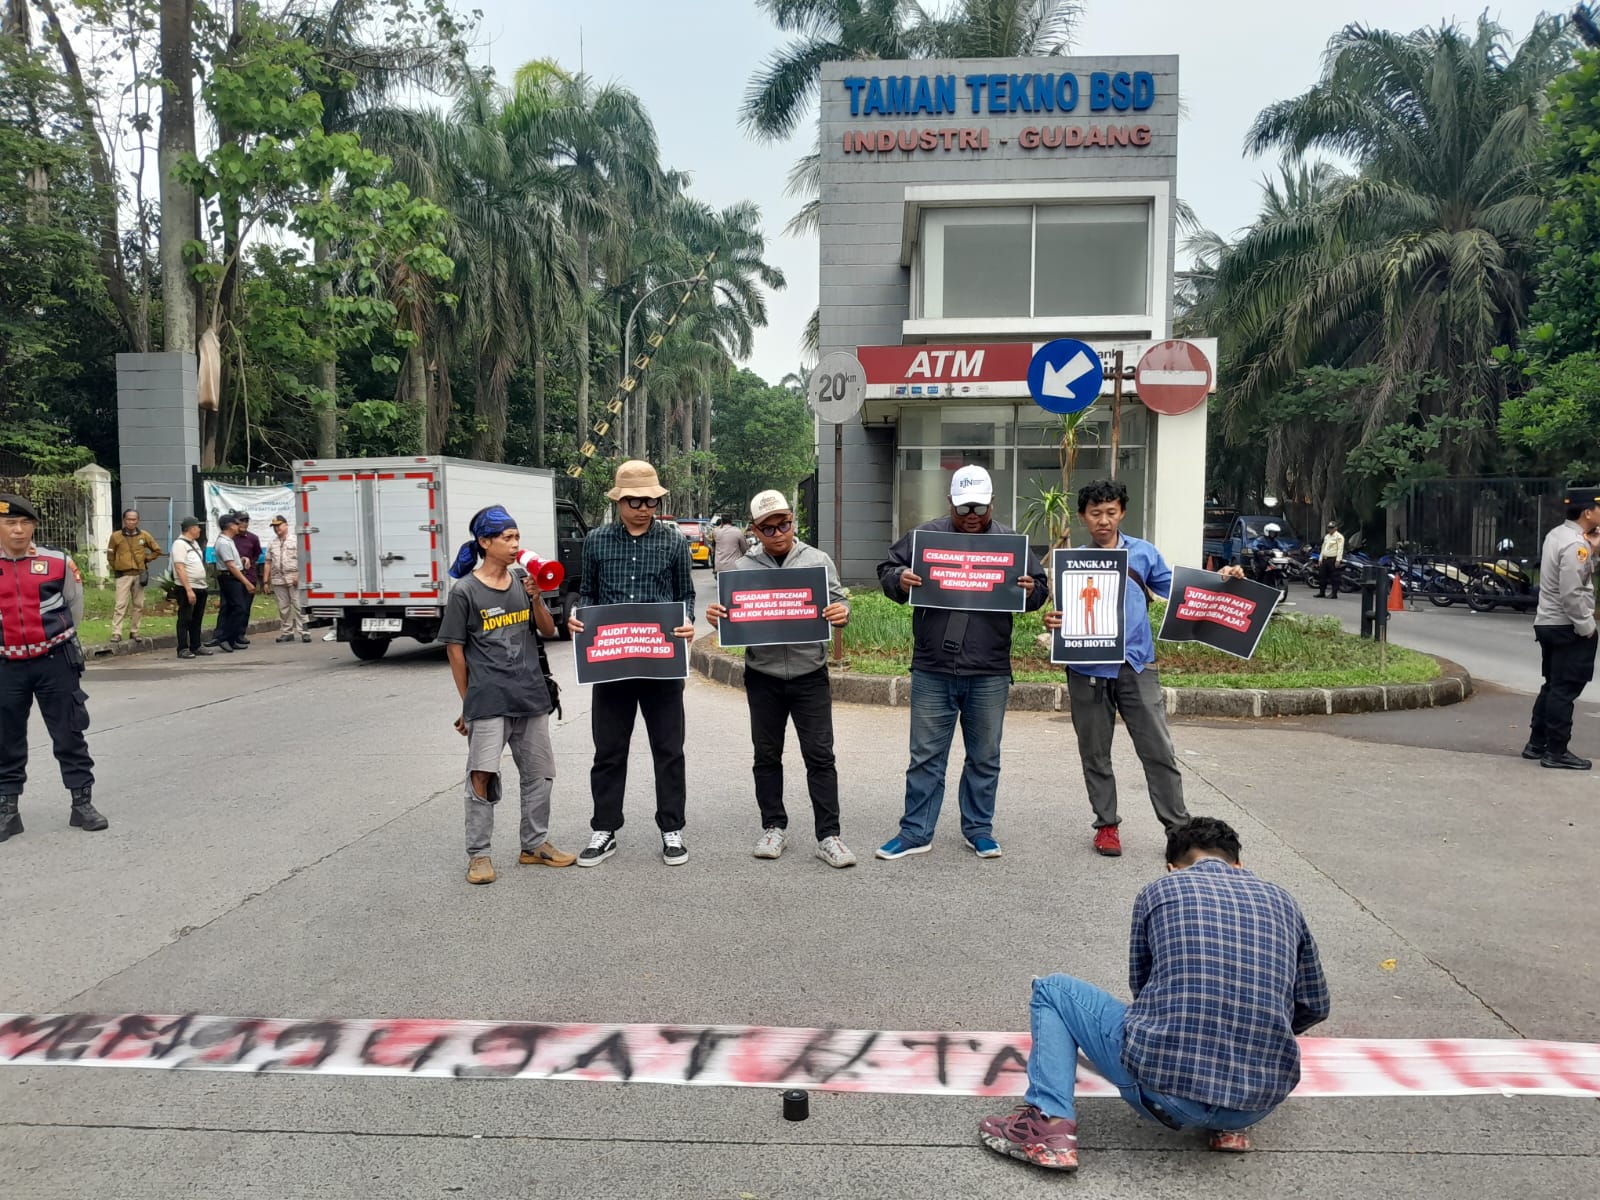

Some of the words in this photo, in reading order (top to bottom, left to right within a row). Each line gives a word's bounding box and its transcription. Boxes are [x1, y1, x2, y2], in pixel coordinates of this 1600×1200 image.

[845, 75, 956, 115] TAMAN
[966, 73, 1079, 113] TEKNO
[1090, 71, 1155, 111] BSD
[843, 126, 990, 153] INDUSTRI
[1018, 124, 1152, 149] GUDANG
[1097, 348, 1117, 359] ank
[904, 350, 985, 379] ATM
[926, 552, 965, 562] CISADANE
[966, 554, 1009, 563] TERCEMAR
[1066, 560, 1113, 569] TANGKAP
[932, 570, 967, 579] MATINYA
[968, 572, 1001, 580] SUMBER
[942, 580, 989, 588] KEHIDUPAN
[735, 593, 771, 602] CISADANE
[1231, 599, 1253, 611] MATI
[786, 608, 815, 616] SENYUM
[1180, 608, 1194, 616] KLH
[1218, 604, 1246, 618] RUSAK
[601, 626, 629, 637] AUDIT
[630, 626, 658, 634] WWTP
[597, 636, 663, 647] PERGUDANGAN
[1064, 640, 1083, 648] BOS
[1083, 639, 1117, 647] BIOTEK
[590, 647, 622, 658] TAMAN
[624, 646, 651, 654] TEKNO
[652, 646, 671, 654] BSD
